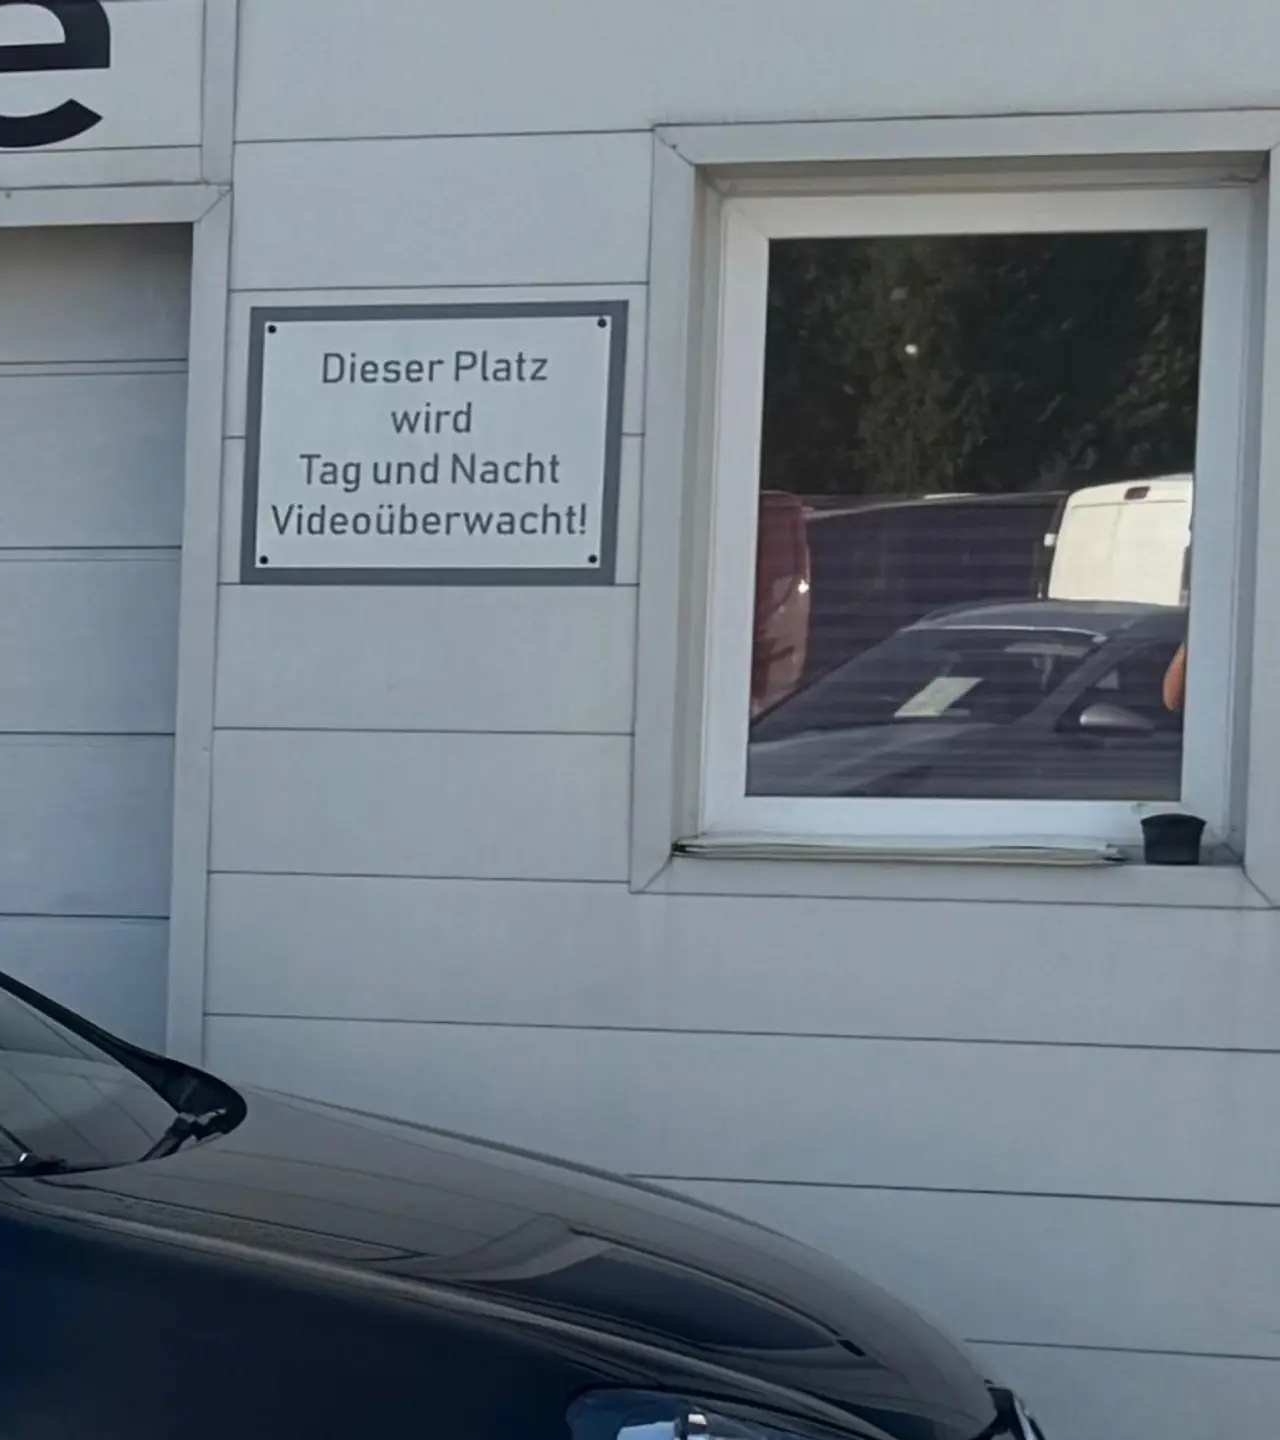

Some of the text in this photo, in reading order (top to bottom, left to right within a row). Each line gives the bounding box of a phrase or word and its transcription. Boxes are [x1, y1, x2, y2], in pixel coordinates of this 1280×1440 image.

[322, 350, 548, 384] Dieser Platz
[391, 401, 472, 434] wird
[299, 452, 560, 493] Tag und Nacht
[271, 503, 587, 536] Videoüberwacht!
